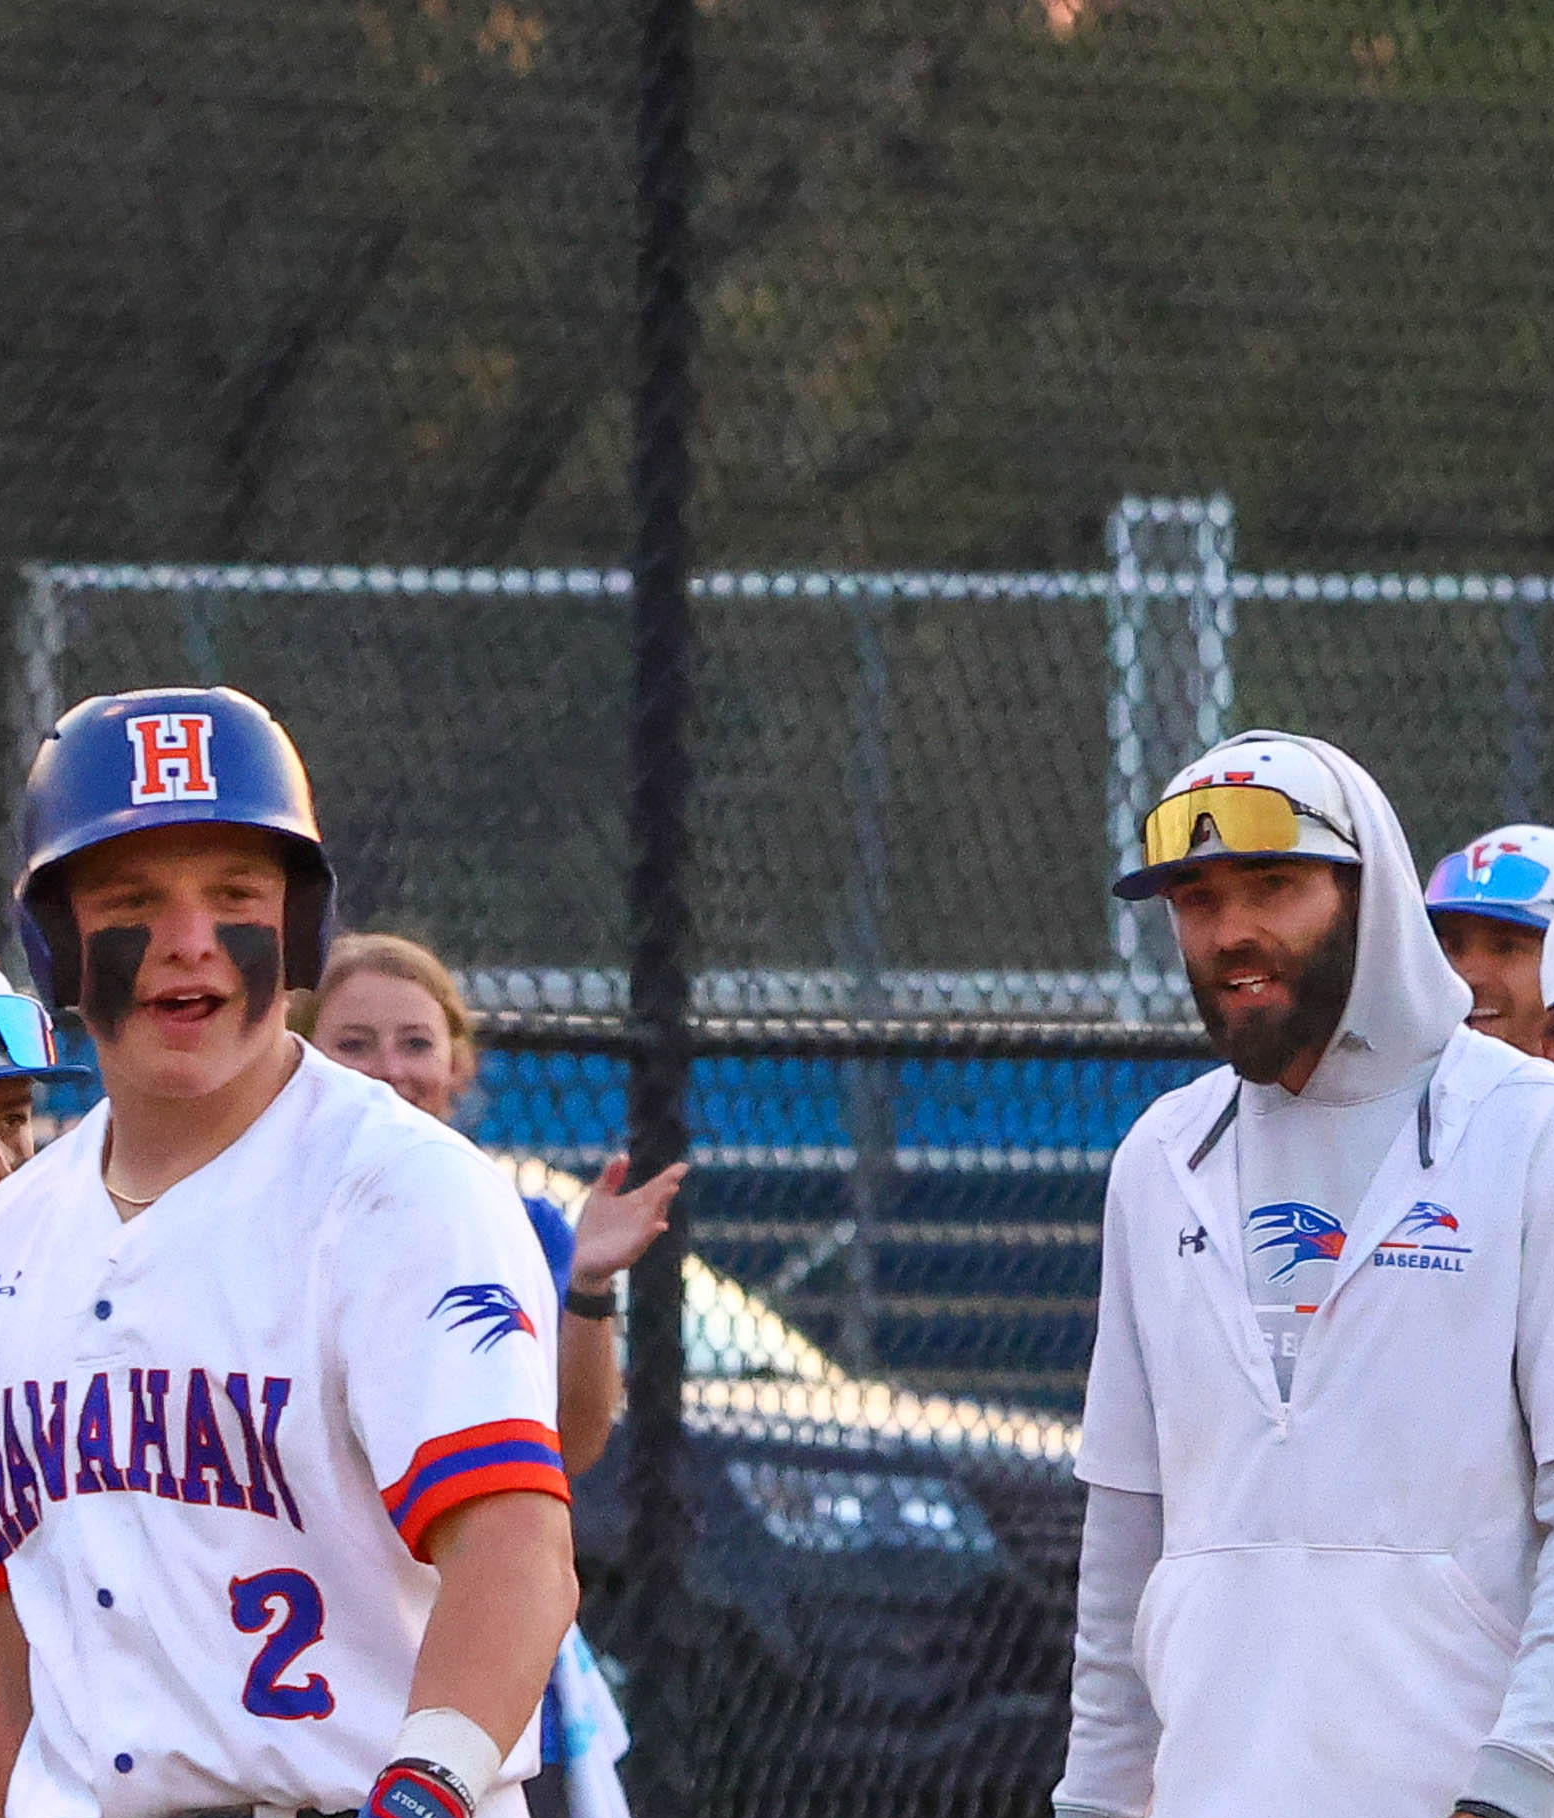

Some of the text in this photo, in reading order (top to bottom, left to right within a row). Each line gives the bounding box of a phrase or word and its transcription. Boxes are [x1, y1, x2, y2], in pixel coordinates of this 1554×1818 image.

[125, 713, 217, 802] H
[1373, 1252, 1465, 1272] BASEBALL
[228, 1568, 334, 1720] 2
